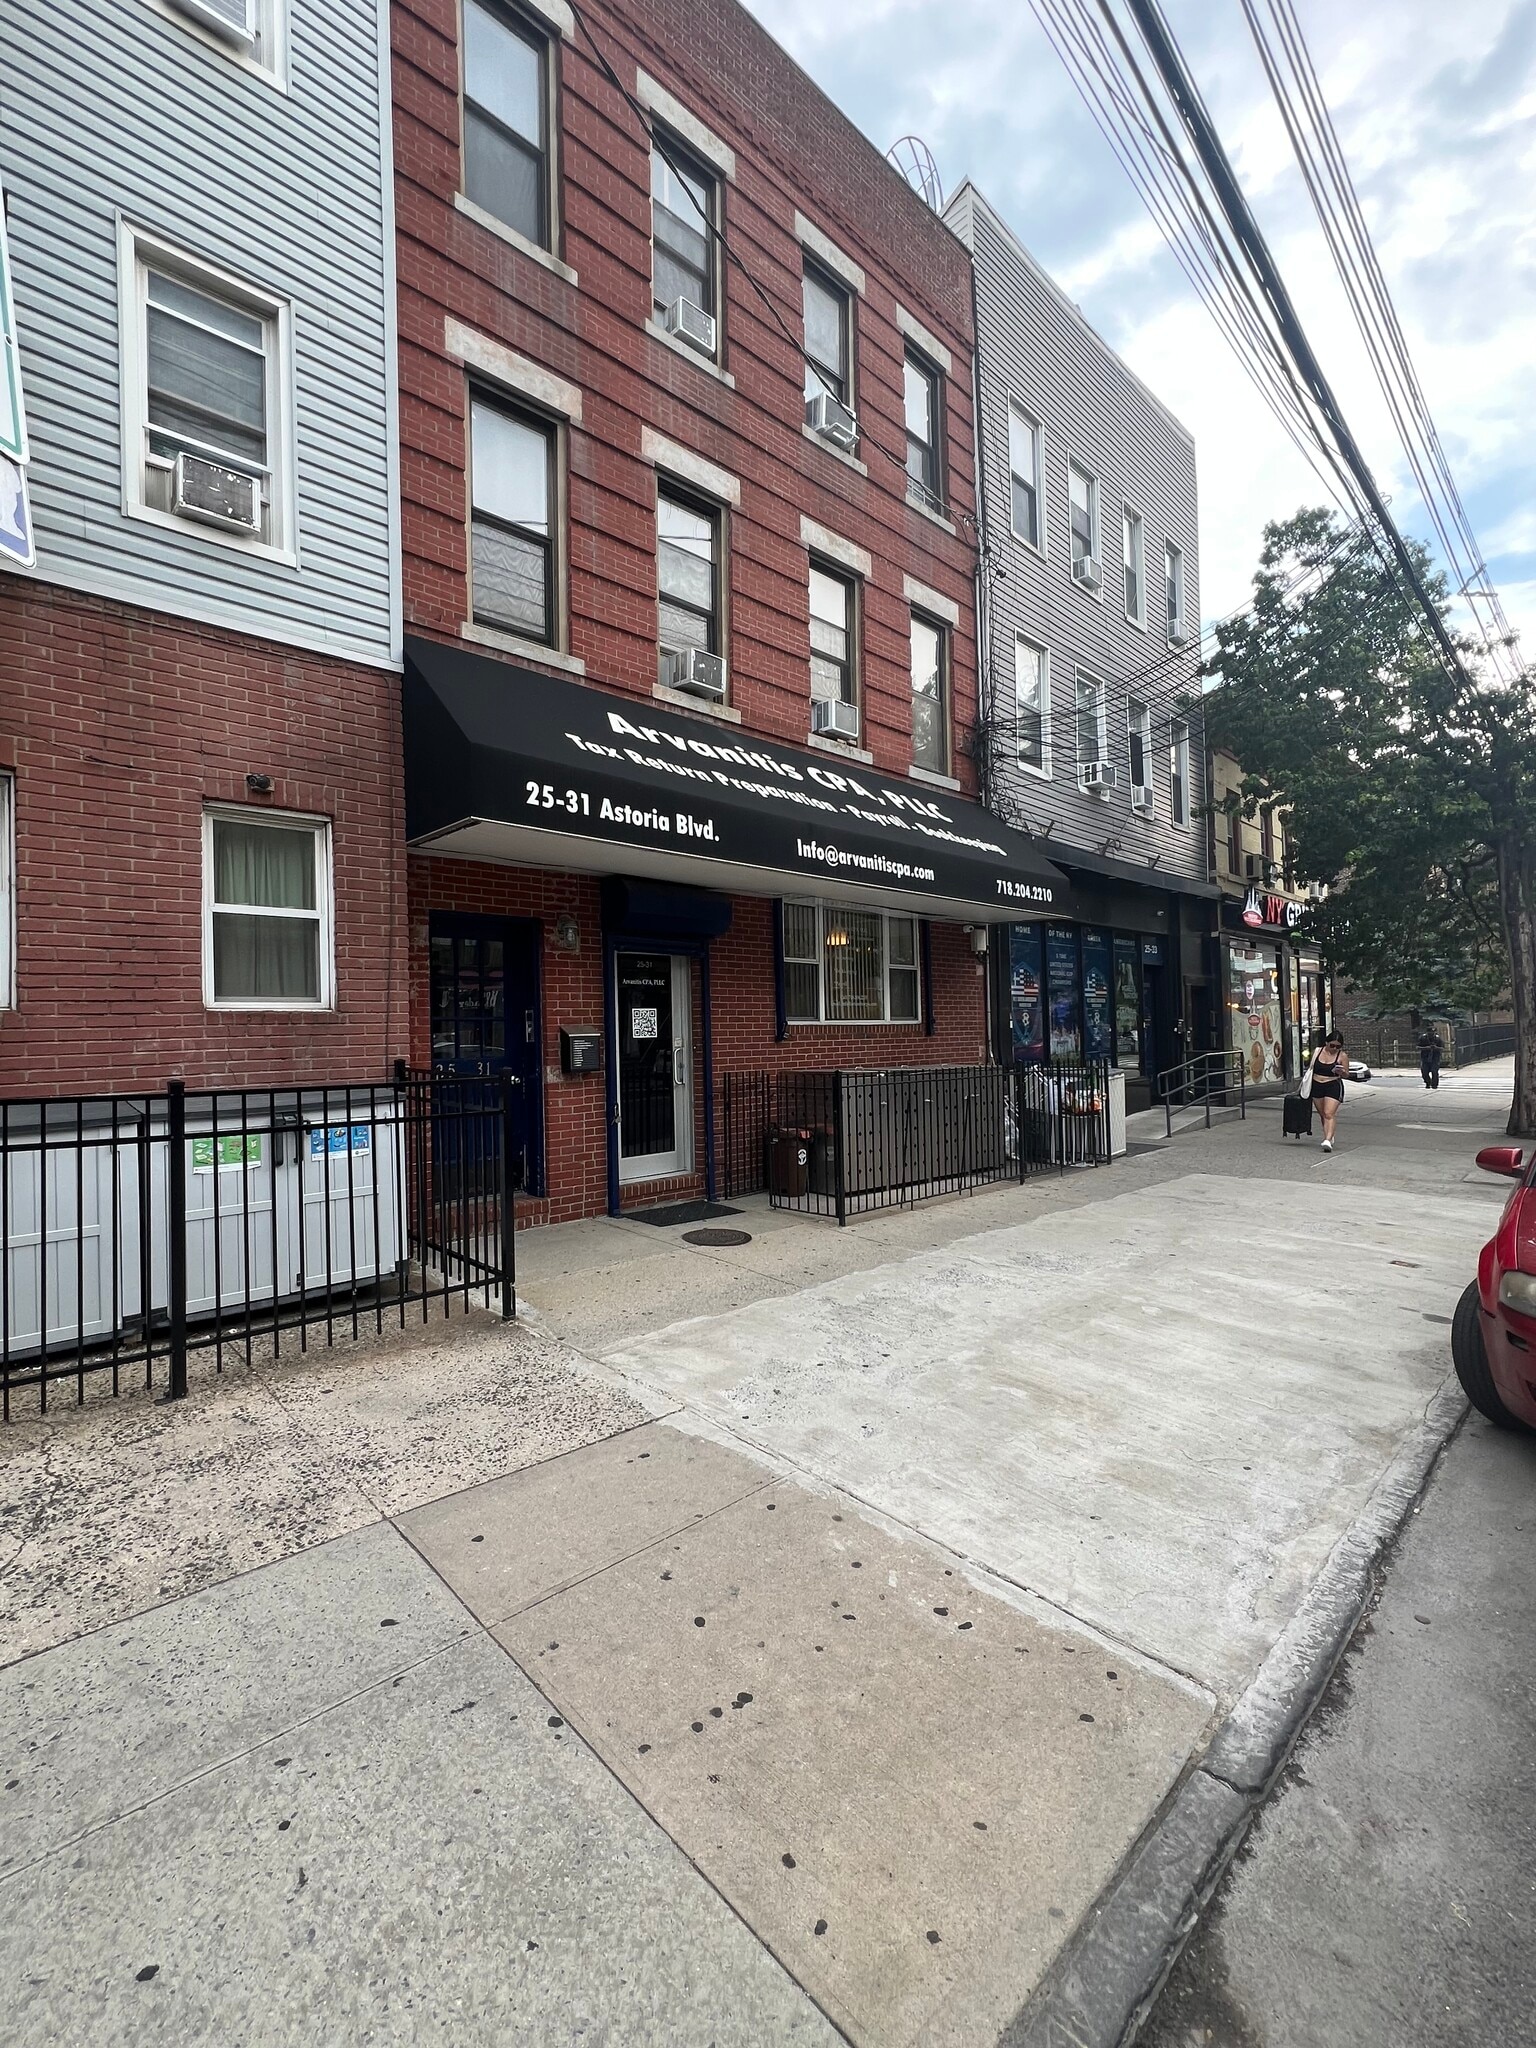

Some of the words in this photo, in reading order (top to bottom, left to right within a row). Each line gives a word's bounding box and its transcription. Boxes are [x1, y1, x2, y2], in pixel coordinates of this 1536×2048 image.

[565, 733, 625, 760] Tax
[623, 748, 713, 782] Return
[711, 770, 838, 813] Preparation
[845, 804, 911, 830] Payroll
[607, 712, 803, 780] Arvanitis
[881, 789, 954, 823] PLLC
[526, 781, 590, 816] 25-31
[600, 798, 670, 832] Astoria
[676, 813, 720, 842] Blvd.
[797, 838, 935, 881] Info@arvanitiscpa.com
[996, 879, 1053, 902] 718.204.2210
[1266, 895, 1284, 924] NY
[1015, 925, 1031, 934] HOME
[1048, 929, 1055, 937] OF
[1056, 930, 1065, 939] THE
